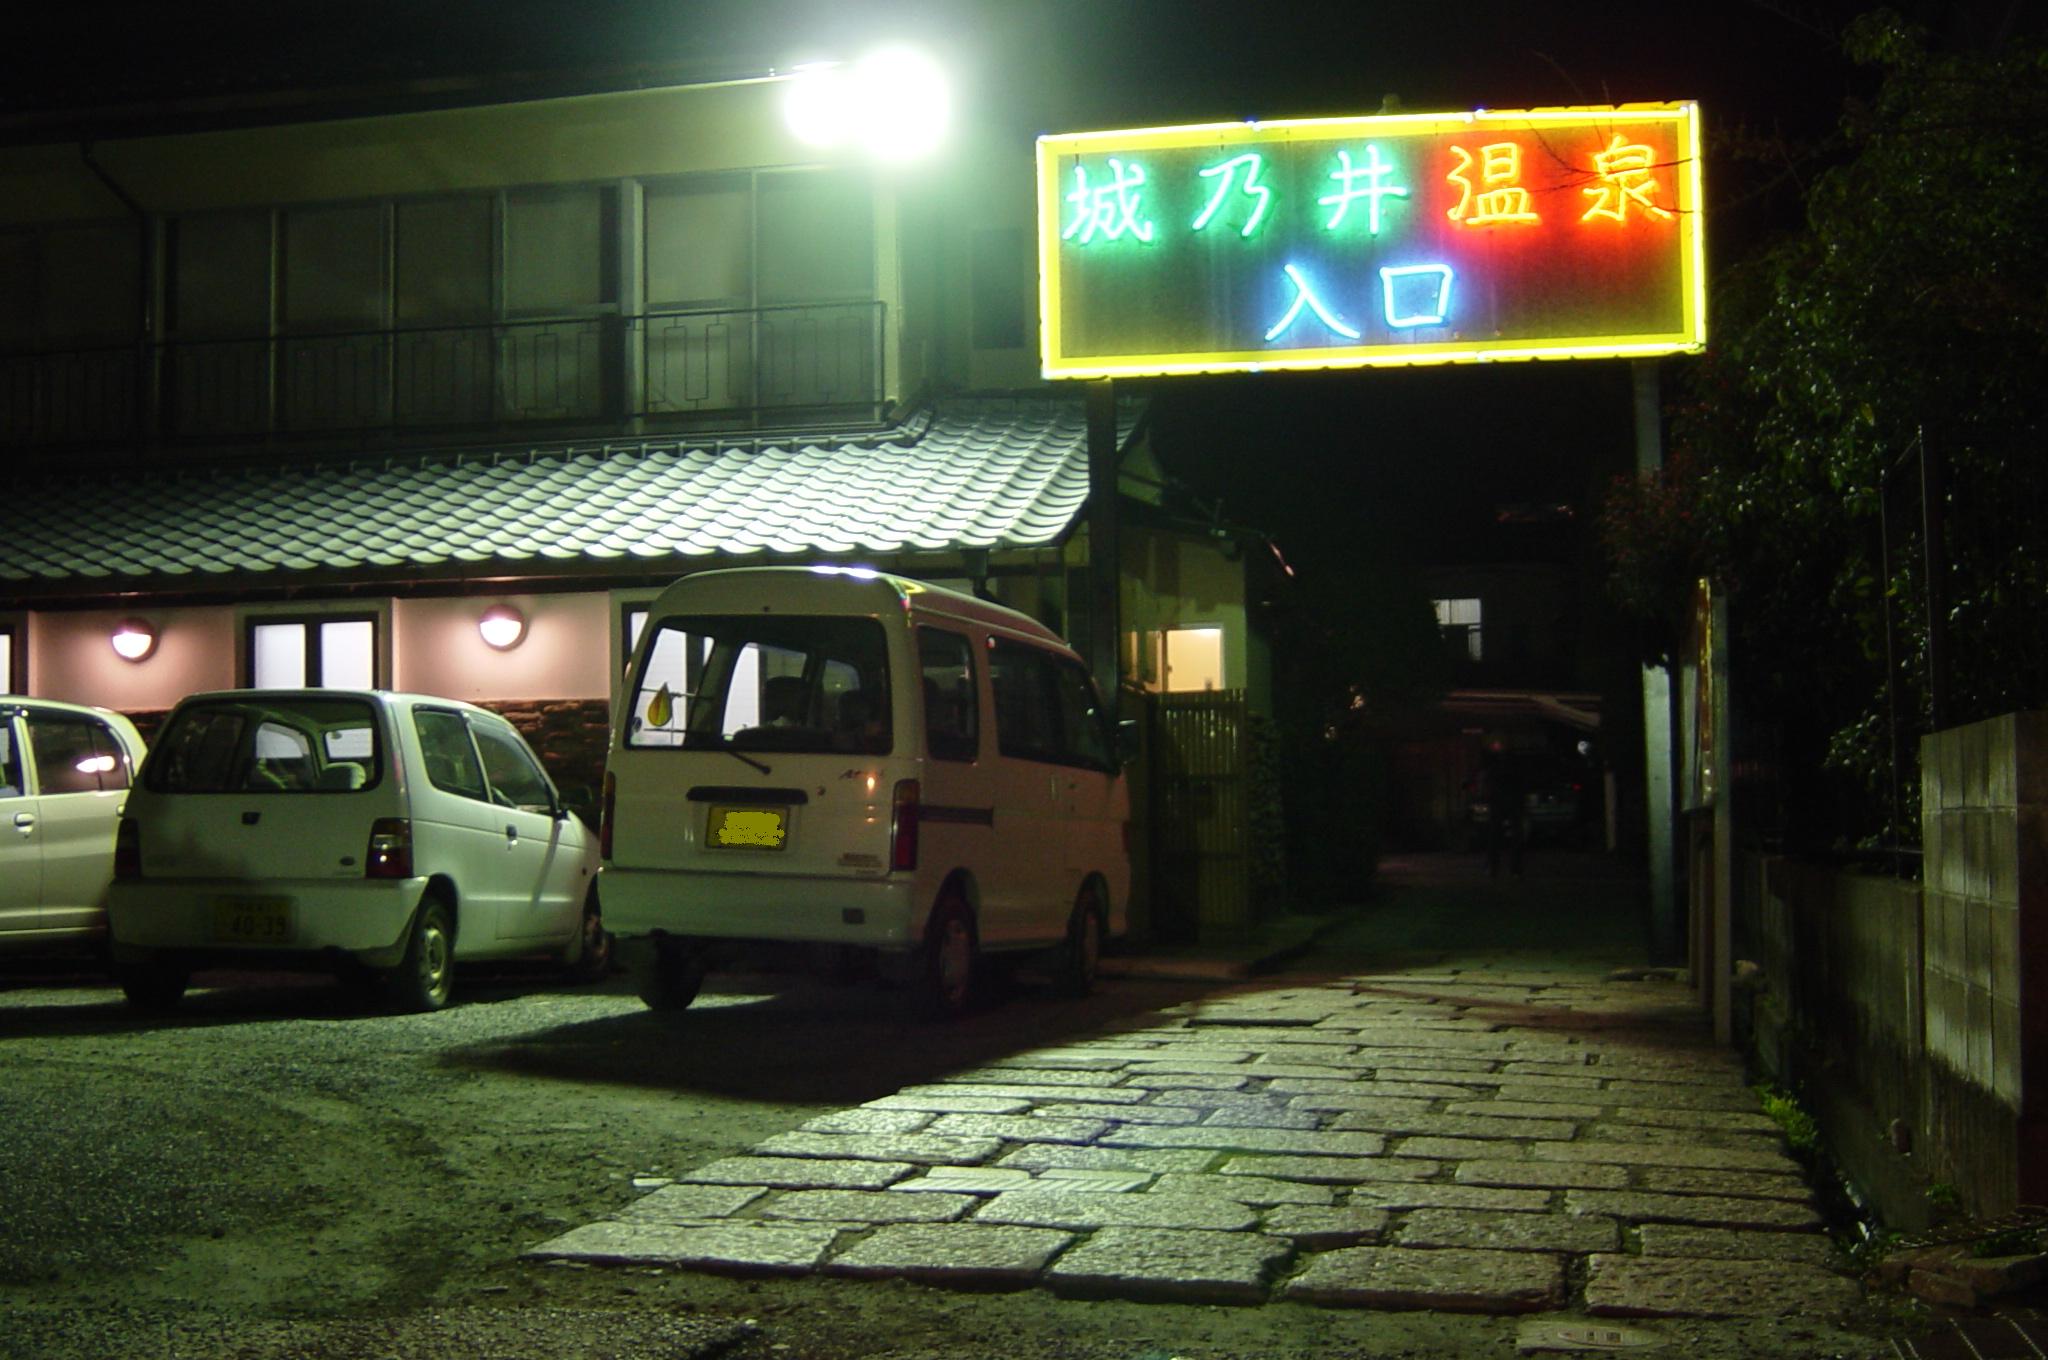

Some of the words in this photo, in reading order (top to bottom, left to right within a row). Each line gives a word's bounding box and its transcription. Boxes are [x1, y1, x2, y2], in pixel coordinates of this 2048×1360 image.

[1061, 134, 1674, 244] 城乃井温泉
[1263, 262, 1455, 341] 入口
